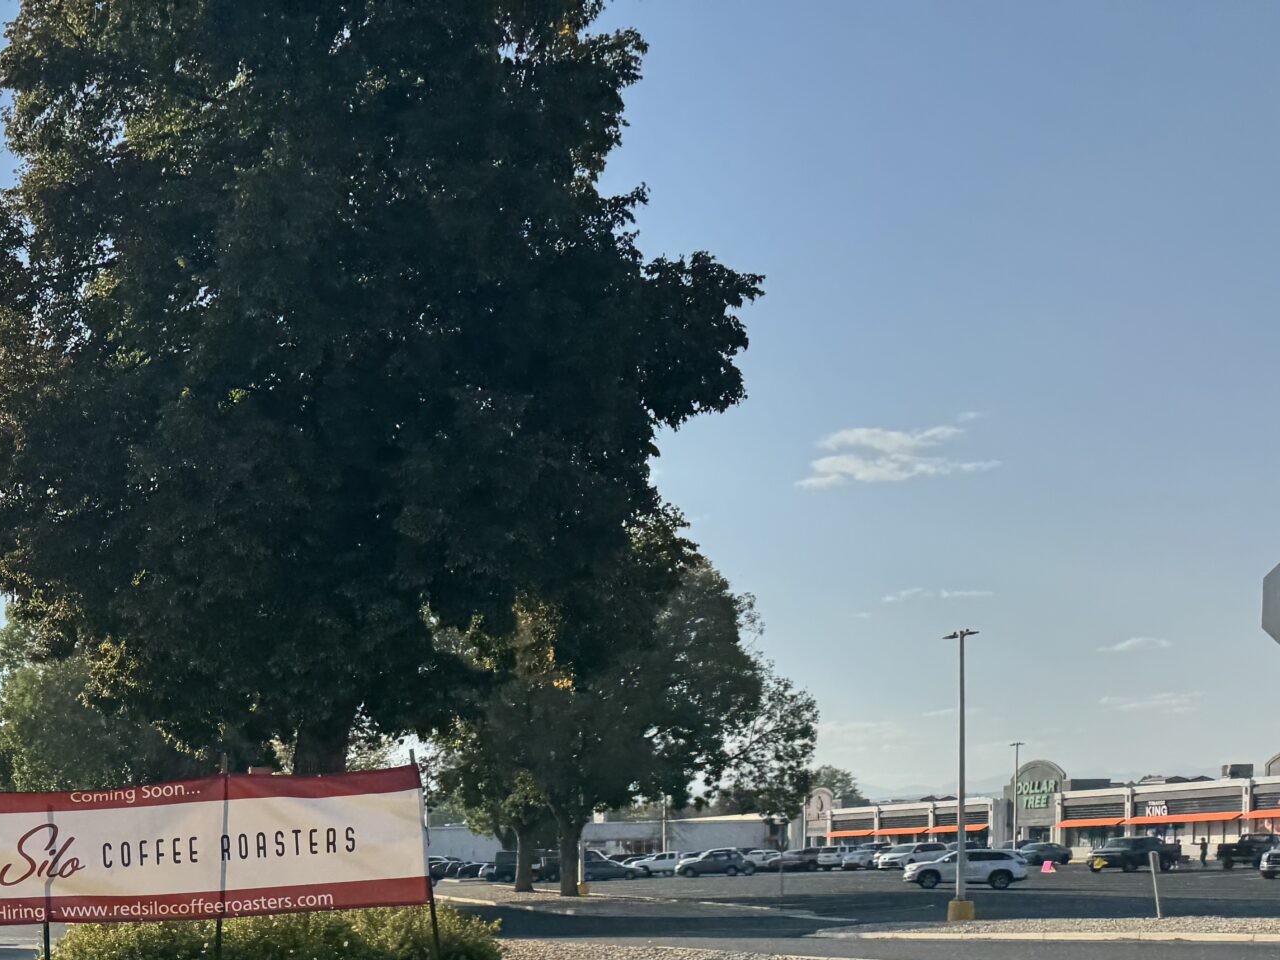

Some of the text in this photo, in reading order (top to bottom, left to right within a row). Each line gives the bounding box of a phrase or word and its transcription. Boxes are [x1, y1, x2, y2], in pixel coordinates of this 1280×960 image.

[70, 784, 201, 804] Coming Soon...
[1017, 780, 1055, 795] DOLLAR
[1023, 795, 1048, 809] TREE
[1145, 805, 1168, 817] KING
[0, 823, 86, 887] Silo
[102, 836, 199, 868] COFFEE
[221, 827, 356, 861] ROASTERS
[61, 893, 334, 917] www.redsilocoffeeroasters.com
